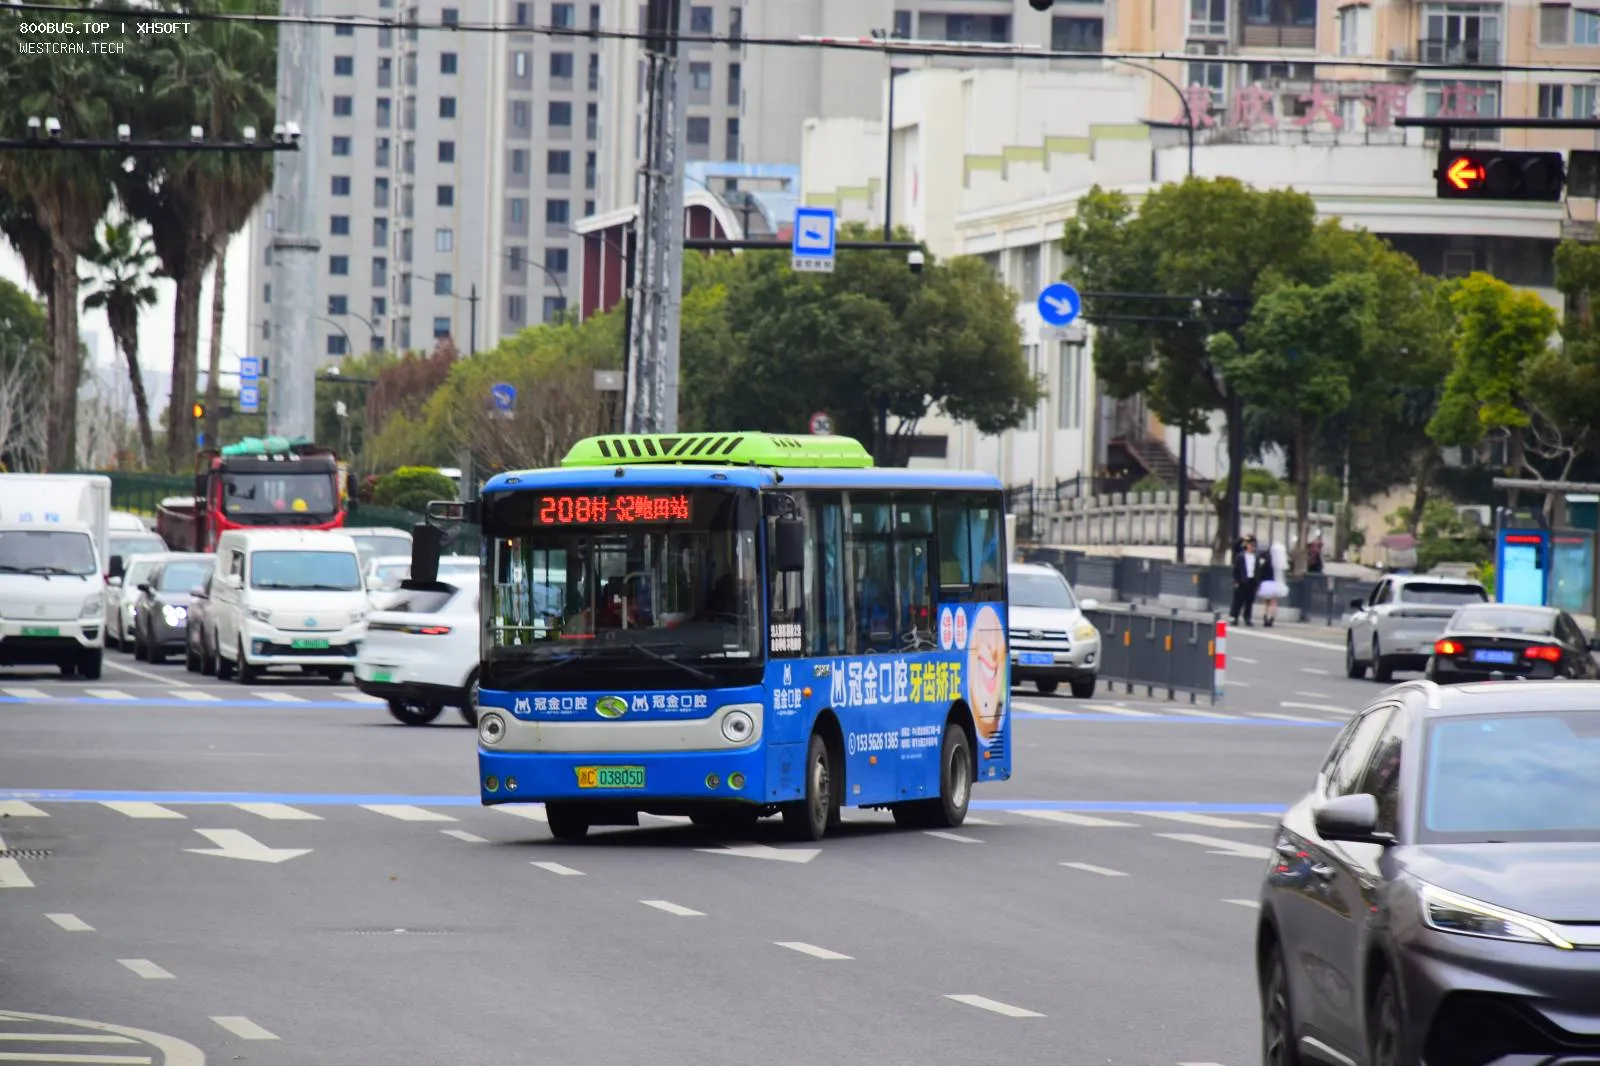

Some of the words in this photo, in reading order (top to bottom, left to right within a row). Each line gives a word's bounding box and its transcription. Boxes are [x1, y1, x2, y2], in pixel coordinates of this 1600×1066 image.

[814, 419, 830, 431] 30
[848, 660, 908, 706] 冠金口腔
[909, 661, 962, 704] 牙齿矫正
[534, 696, 588, 711] 冠金口腔
[652, 694, 708, 709] 冠金口腔
[773, 688, 802, 710] 冠金口腔
[856, 733, 867, 752] 153
[884, 731, 898, 750] 1365
